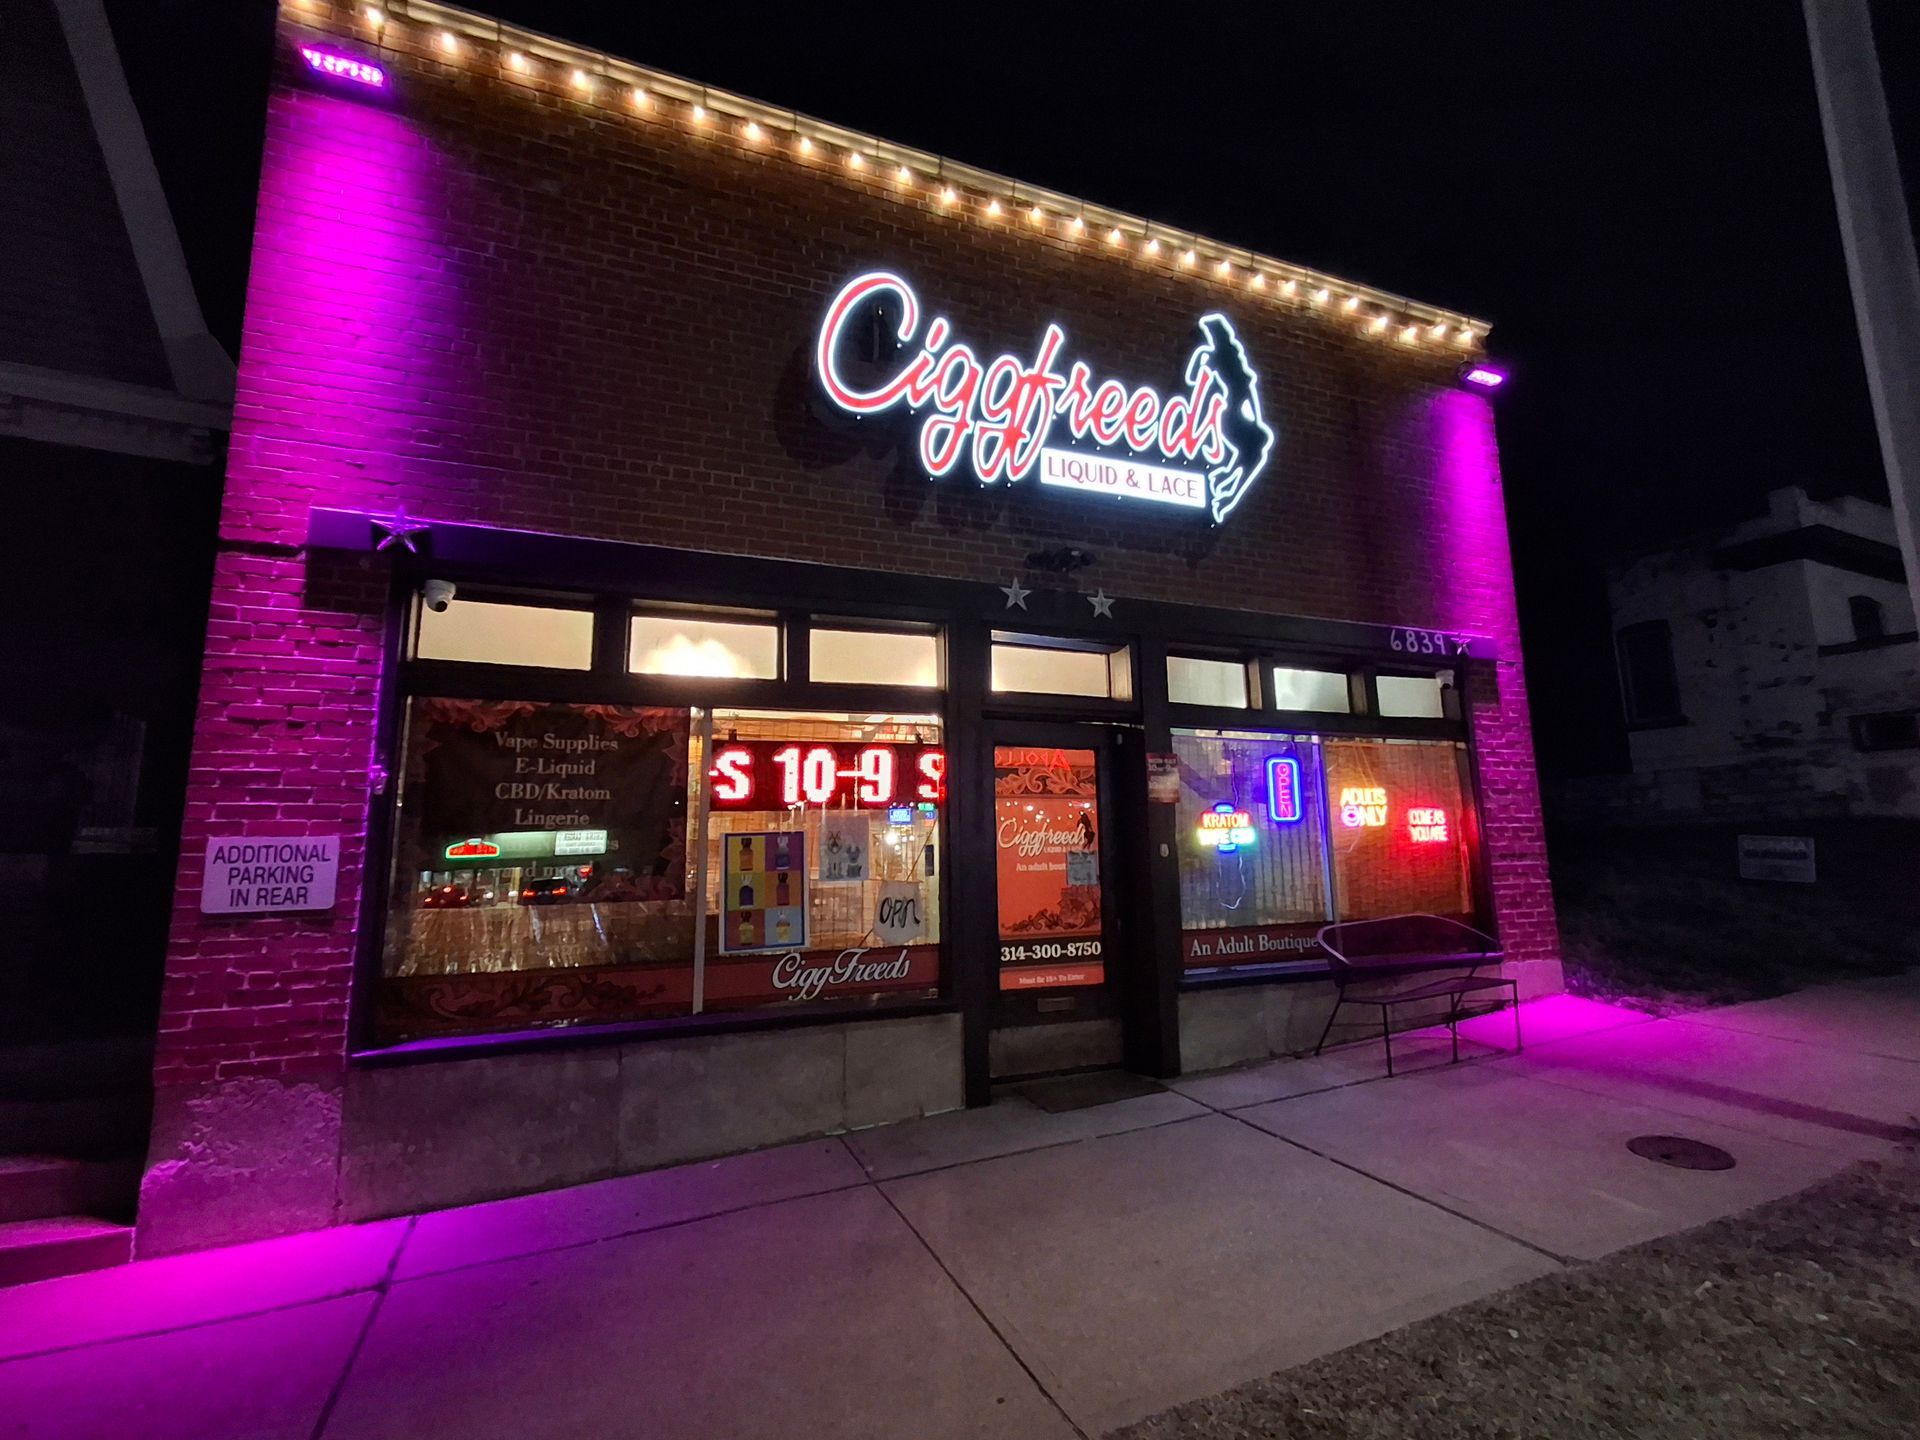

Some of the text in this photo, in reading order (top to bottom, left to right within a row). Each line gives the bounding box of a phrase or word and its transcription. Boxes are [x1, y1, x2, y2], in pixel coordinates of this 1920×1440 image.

[817, 271, 1228, 484] Ciggfreeds
[1047, 456, 1200, 500] LIQUID & LACE
[1390, 629, 1446, 655] 6839
[495, 731, 619, 754] Vape Supplies
[515, 757, 596, 778] E-Liquid
[773, 747, 894, 804] 10-9
[495, 782, 611, 801] CBD/Kratom
[1276, 762, 1293, 818] OPEN
[515, 808, 591, 829] Lingerie
[1203, 812, 1249, 829] KRATOM
[1341, 805, 1387, 828] ONLY
[998, 819, 1086, 857] Ciggfreeds
[213, 845, 331, 865] ADDITIONAL
[228, 865, 314, 886] PARKING
[229, 887, 309, 907] IN REAR
[1000, 942, 1102, 961] 314-300-8750
[1191, 933, 1319, 956] An Adult Boutique
[772, 948, 910, 1000] CiggFreeds
